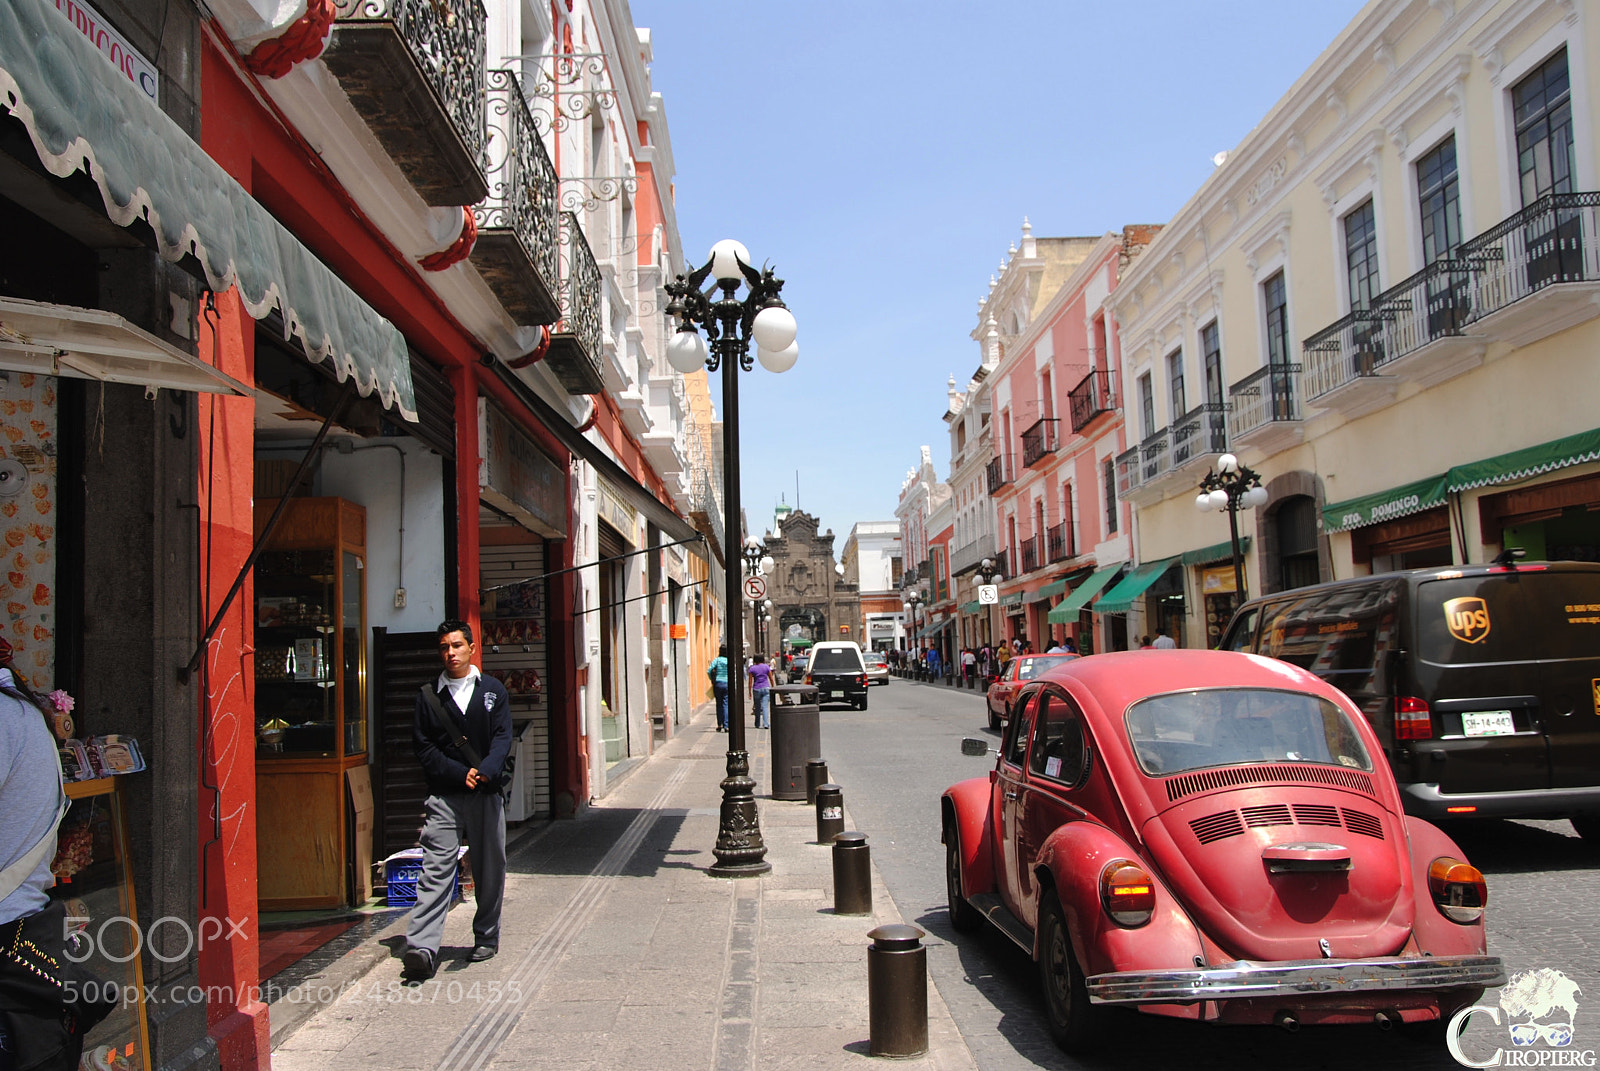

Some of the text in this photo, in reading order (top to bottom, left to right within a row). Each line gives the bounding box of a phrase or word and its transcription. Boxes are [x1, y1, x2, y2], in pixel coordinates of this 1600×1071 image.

[1342, 494, 1419, 526] STO. DOMINGO
[1450, 609, 1488, 637] ups
